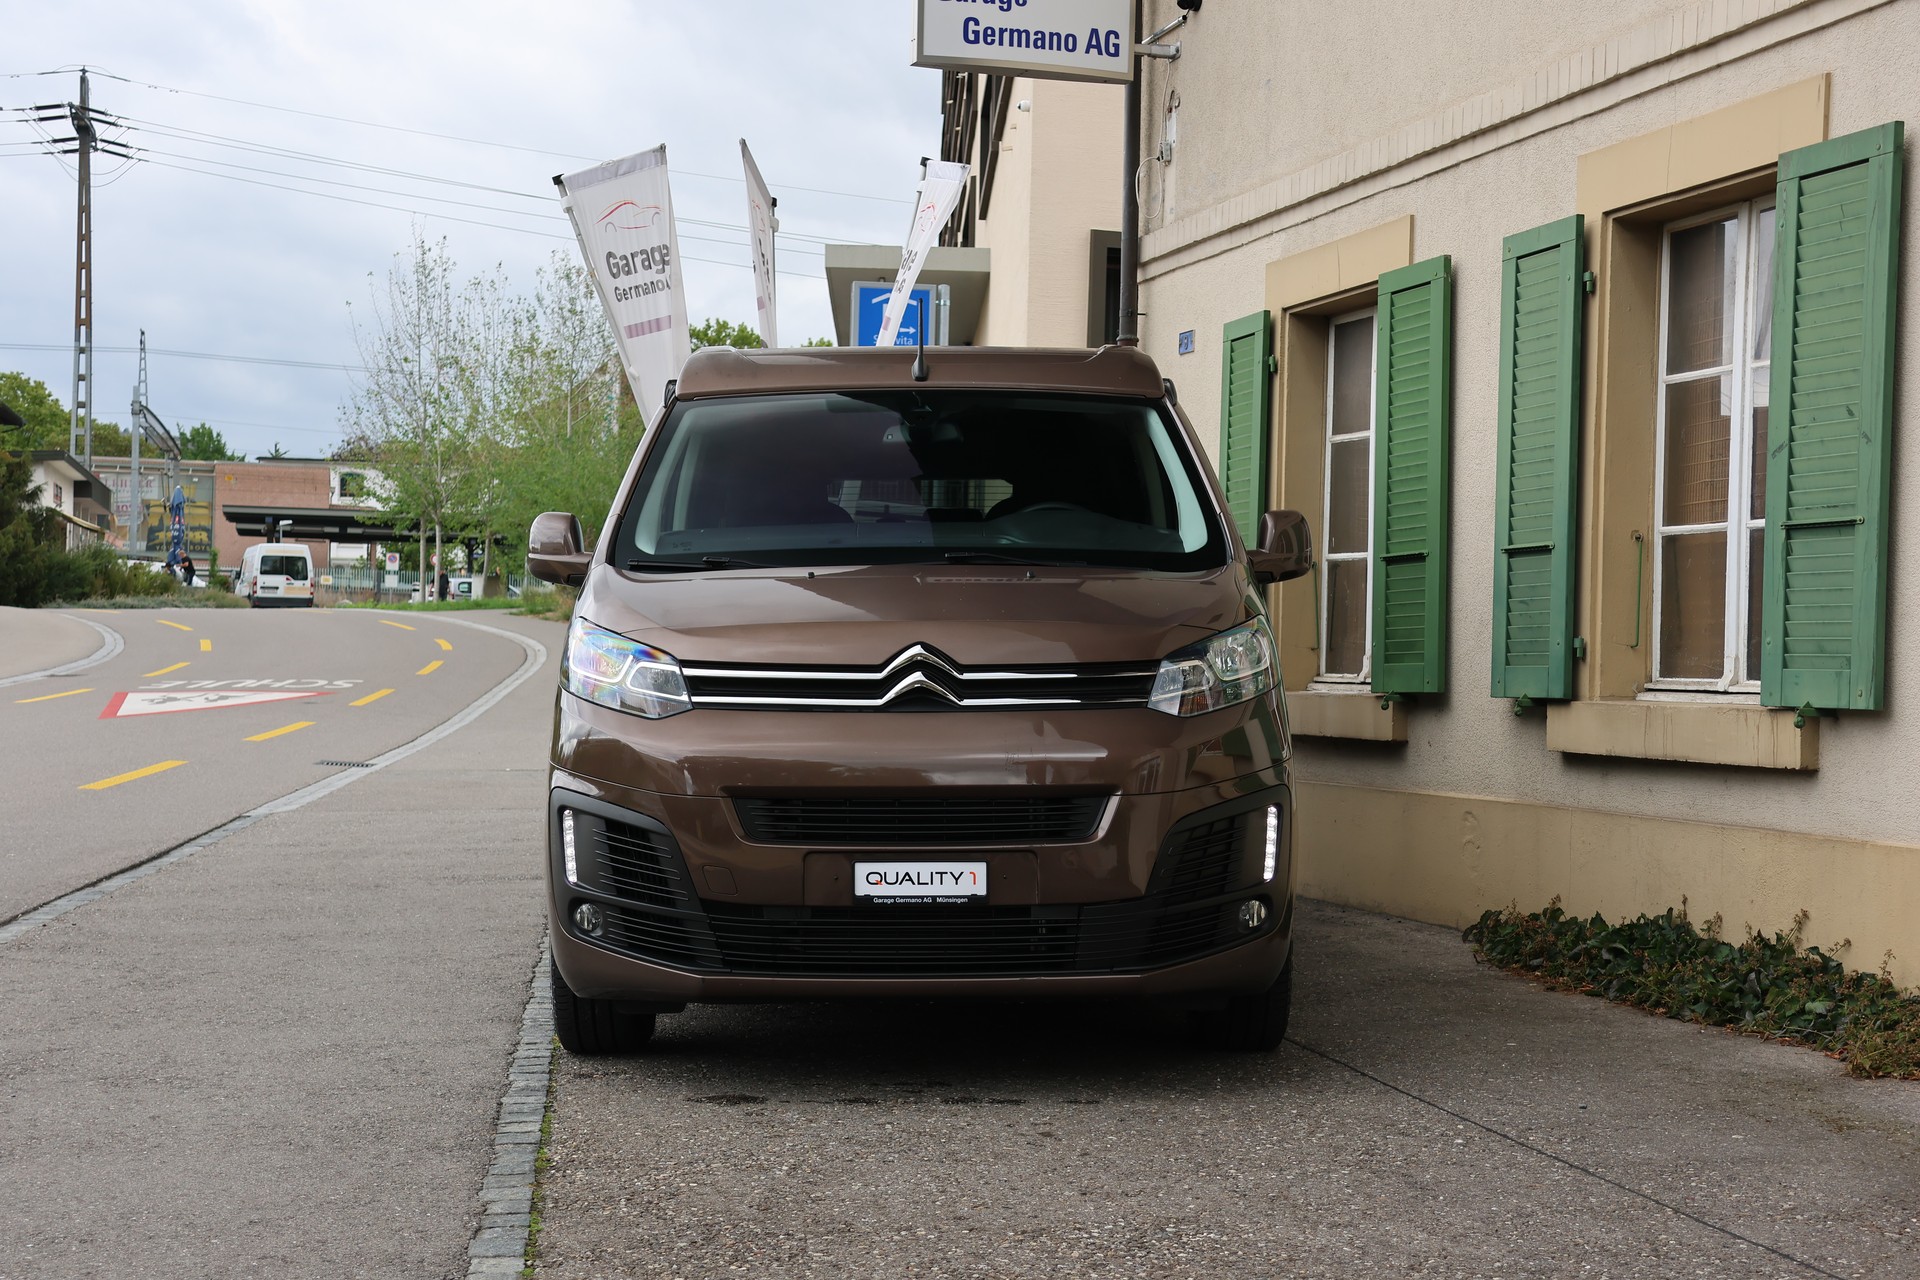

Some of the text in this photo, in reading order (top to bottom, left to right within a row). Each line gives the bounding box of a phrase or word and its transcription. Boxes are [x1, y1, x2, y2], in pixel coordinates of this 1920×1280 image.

[963, 17, 1120, 57] Germano AG
[606, 243, 669, 279] Garage
[614, 278, 666, 303] Germano
[139, 679, 363, 689] SCHULE
[866, 872, 977, 885] QUALITY 1
